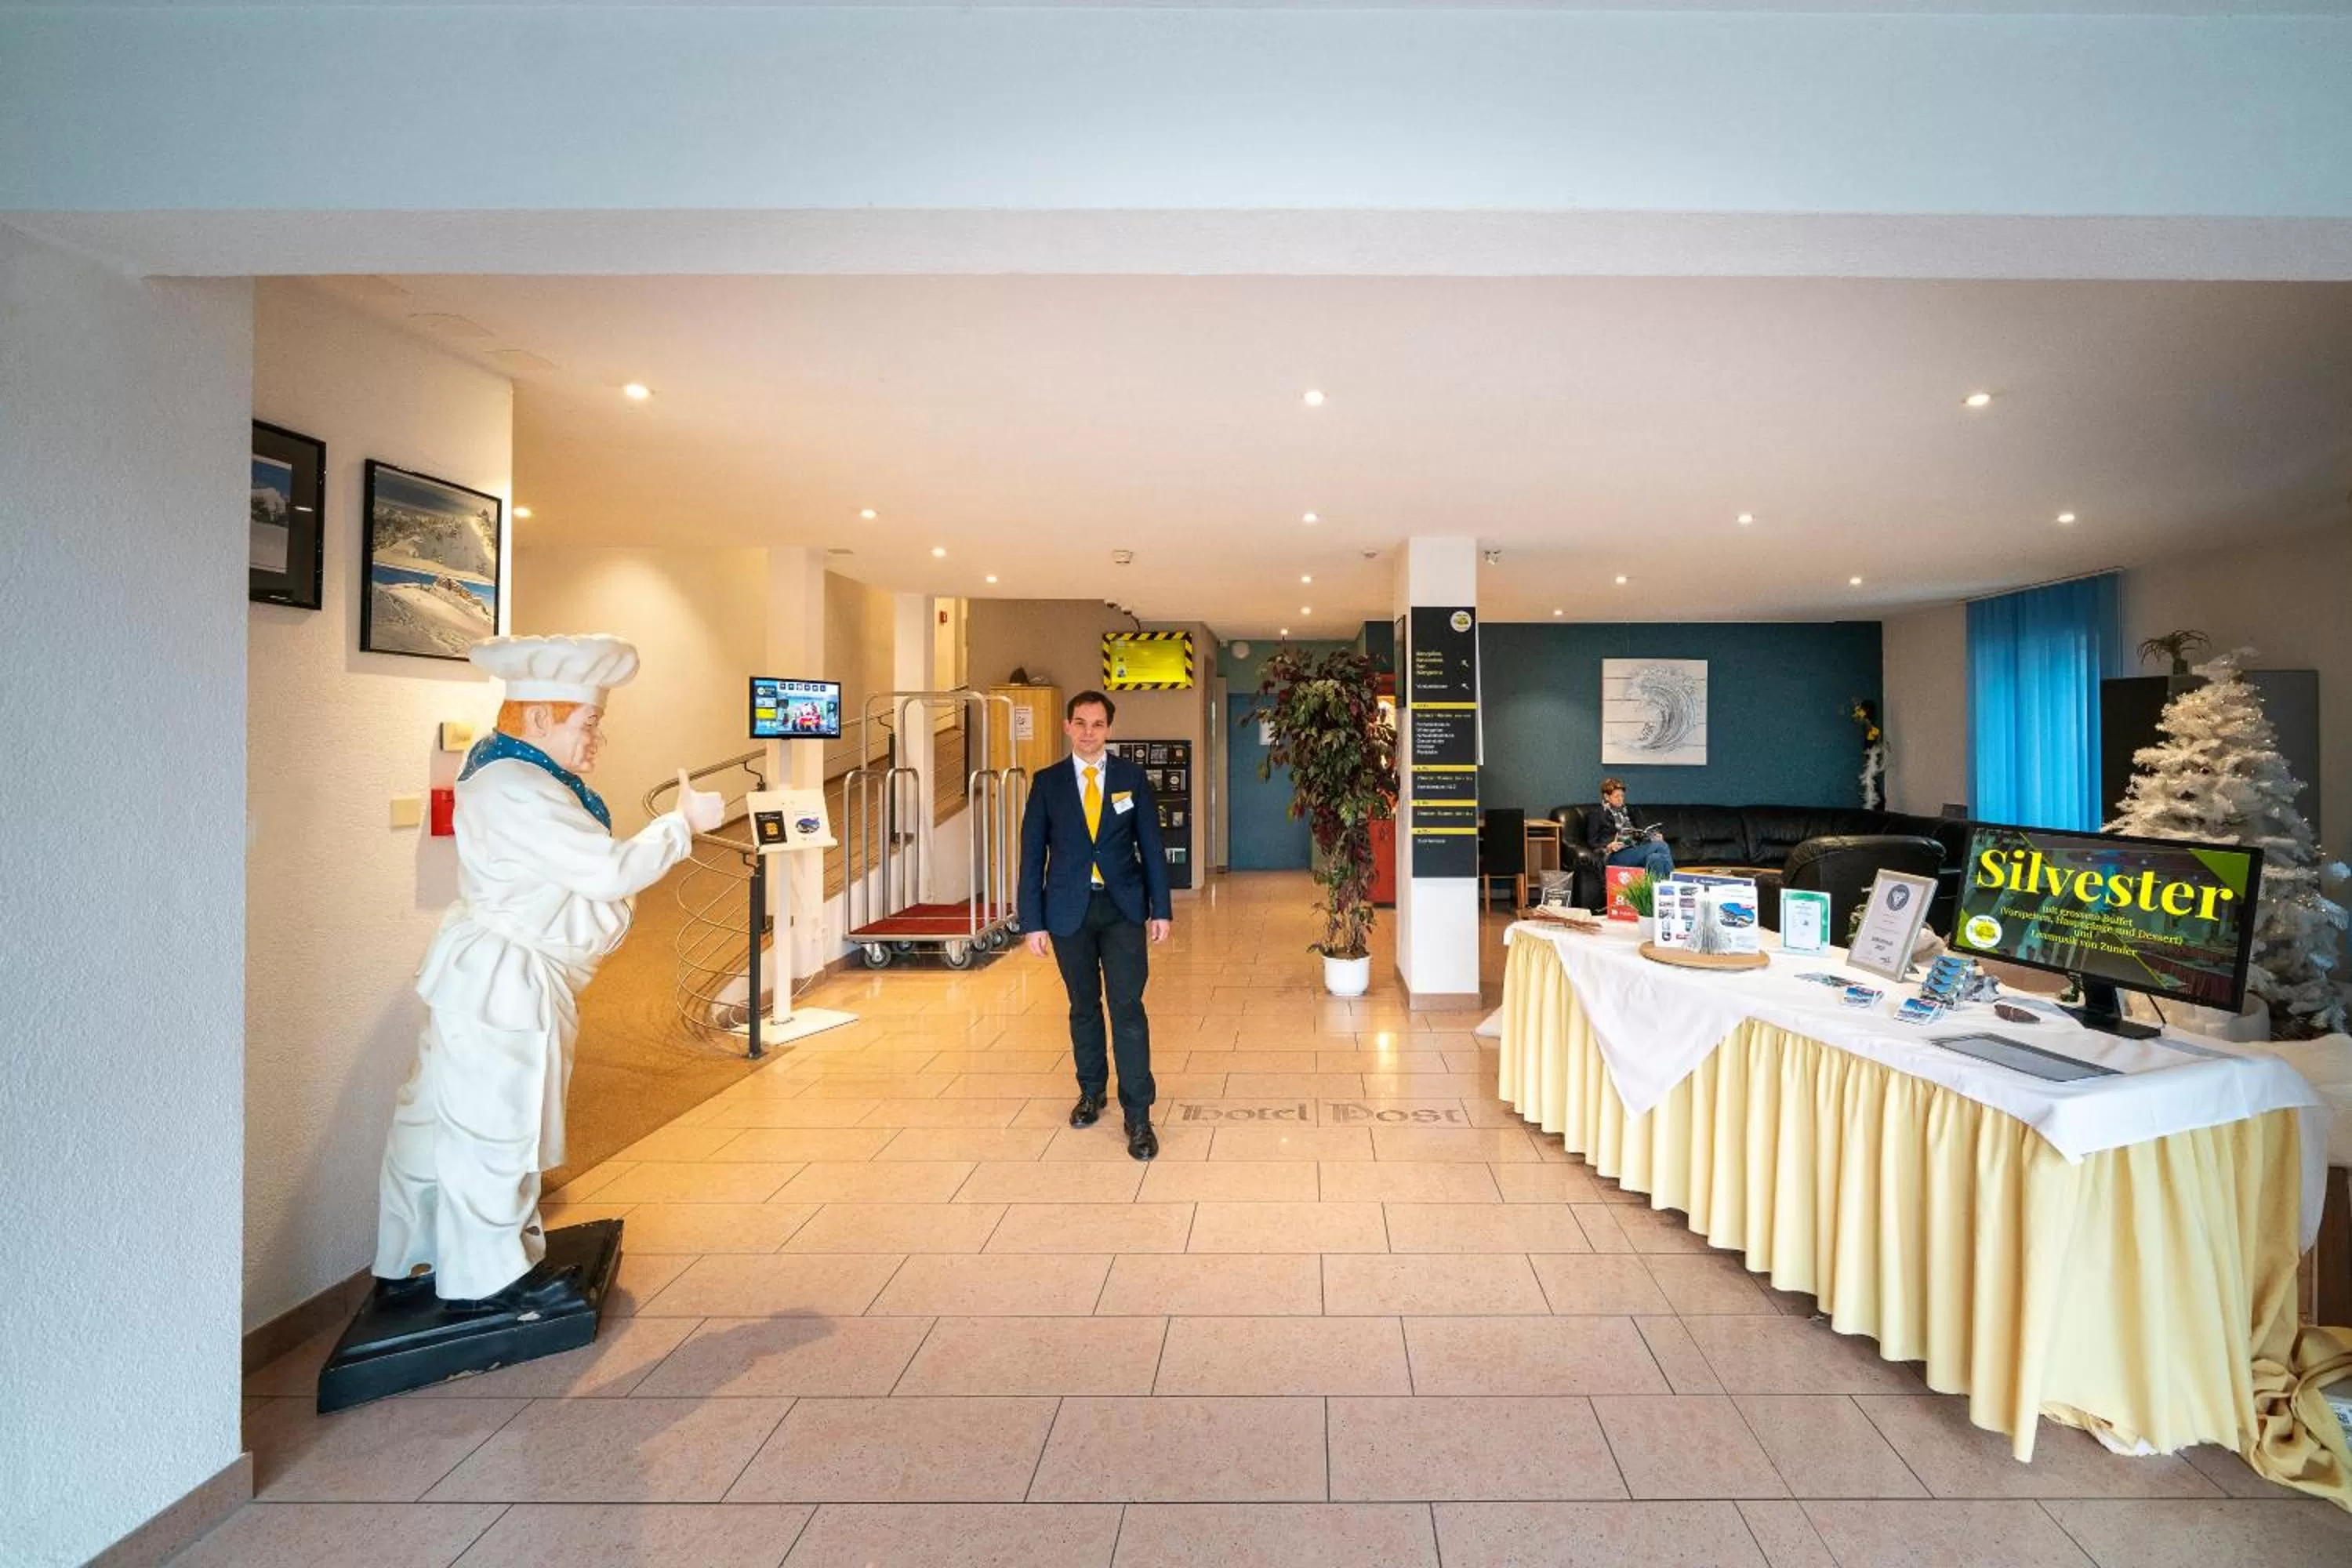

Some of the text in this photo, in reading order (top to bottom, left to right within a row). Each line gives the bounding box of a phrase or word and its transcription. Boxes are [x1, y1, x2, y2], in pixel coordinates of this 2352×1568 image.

[1976, 848, 2234, 922] Silvester
[2102, 914, 2133, 927] Buffet
[2074, 930, 2092, 939] und
[2115, 927, 2136, 937] und
[2138, 929, 2183, 946] Dessert)
[2079, 939, 2097, 949] von
[1325, 1102, 1462, 1123] Post
